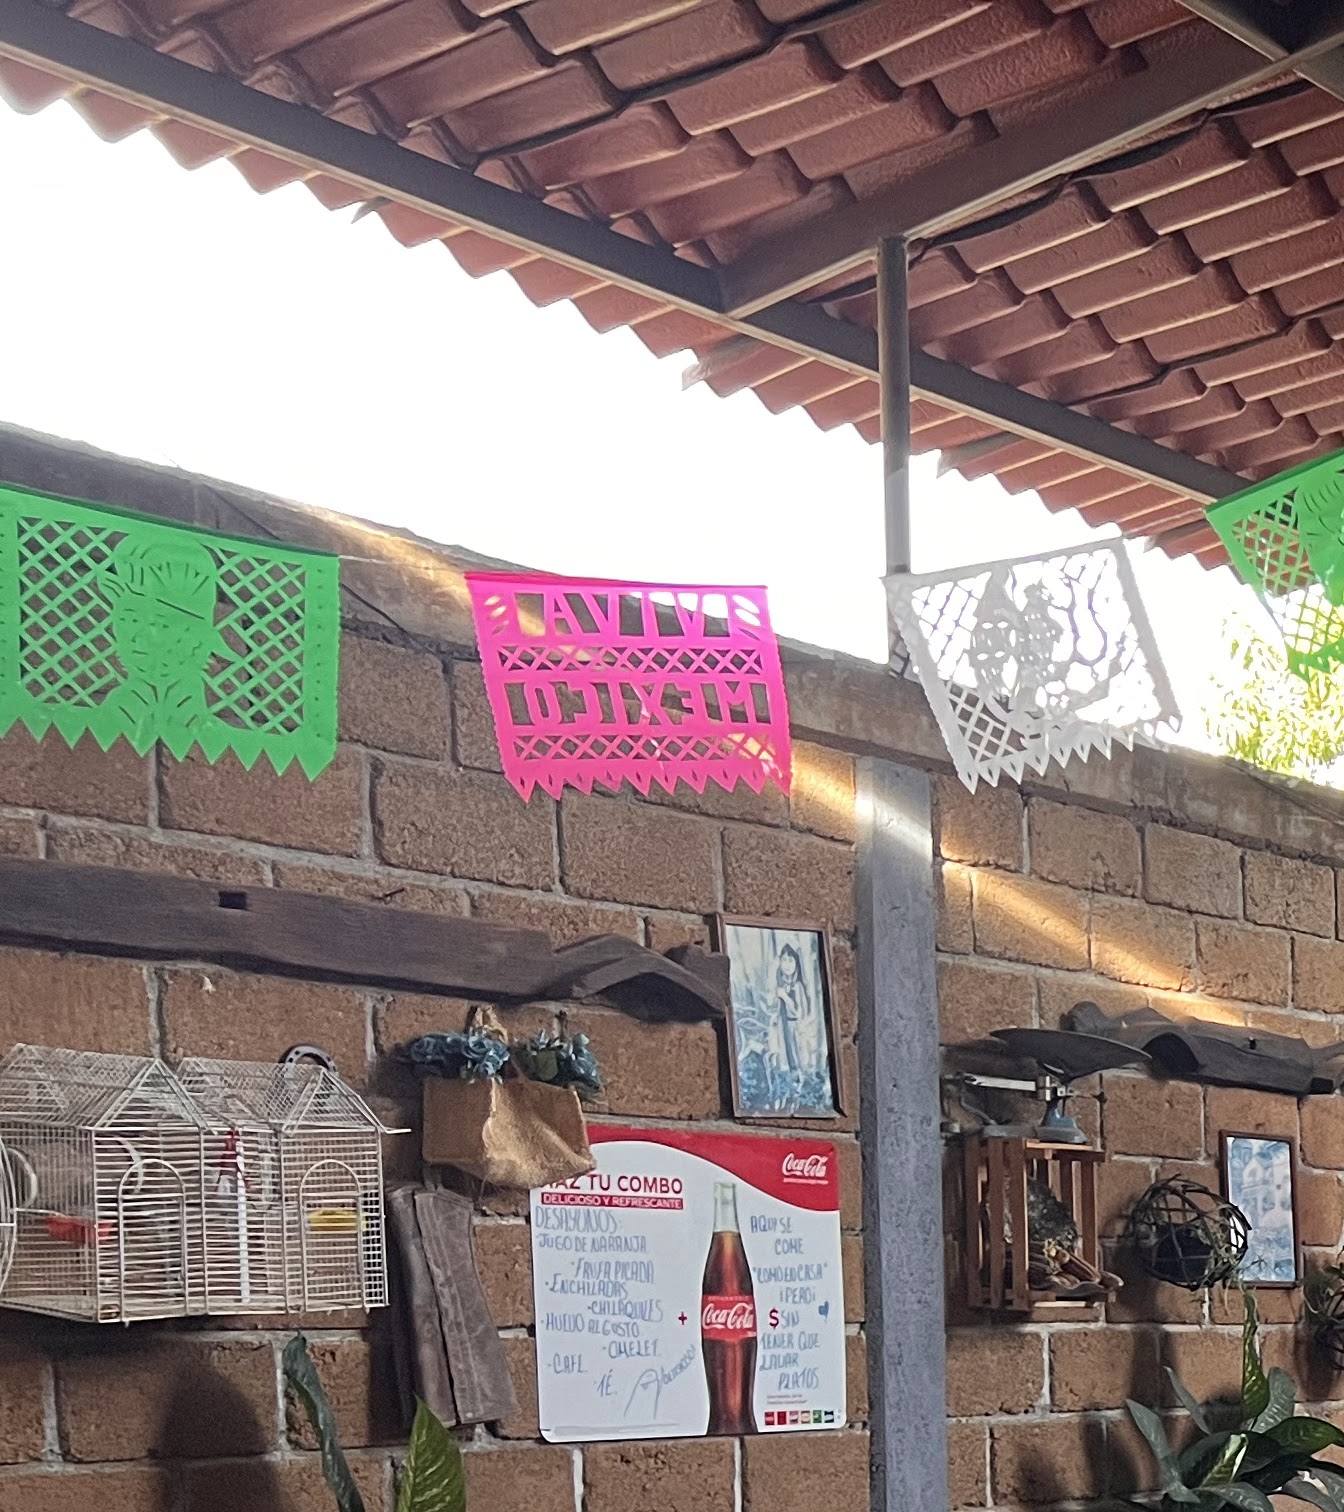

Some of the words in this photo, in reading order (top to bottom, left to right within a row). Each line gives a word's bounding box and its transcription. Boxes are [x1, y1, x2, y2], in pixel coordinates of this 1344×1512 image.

[588, 1174, 610, 1191] TU
[618, 1175, 683, 1194] COMBO
[543, 1194, 601, 1206] DELICIOSO
[602, 1196, 610, 1206] Y
[612, 1198, 682, 1208] REFRESCANTE
[574, 1236, 587, 1252] DE
[590, 1235, 647, 1253] NARANJA
[774, 1238, 804, 1255] COME
[614, 1260, 654, 1284] PICADA
[549, 1273, 628, 1300] ENCHILADAS
[591, 1299, 663, 1322] CHILAQUILES
[769, 1307, 779, 1330] $
[781, 1310, 799, 1329] SIN
[546, 1312, 584, 1332] HUEVO
[588, 1319, 601, 1334] AL
[602, 1320, 639, 1338] GUSTO
[760, 1332, 794, 1350] TENER
[798, 1330, 821, 1351] QUE
[759, 1353, 799, 1371] LAVAR
[777, 1367, 819, 1391] PLATOS
